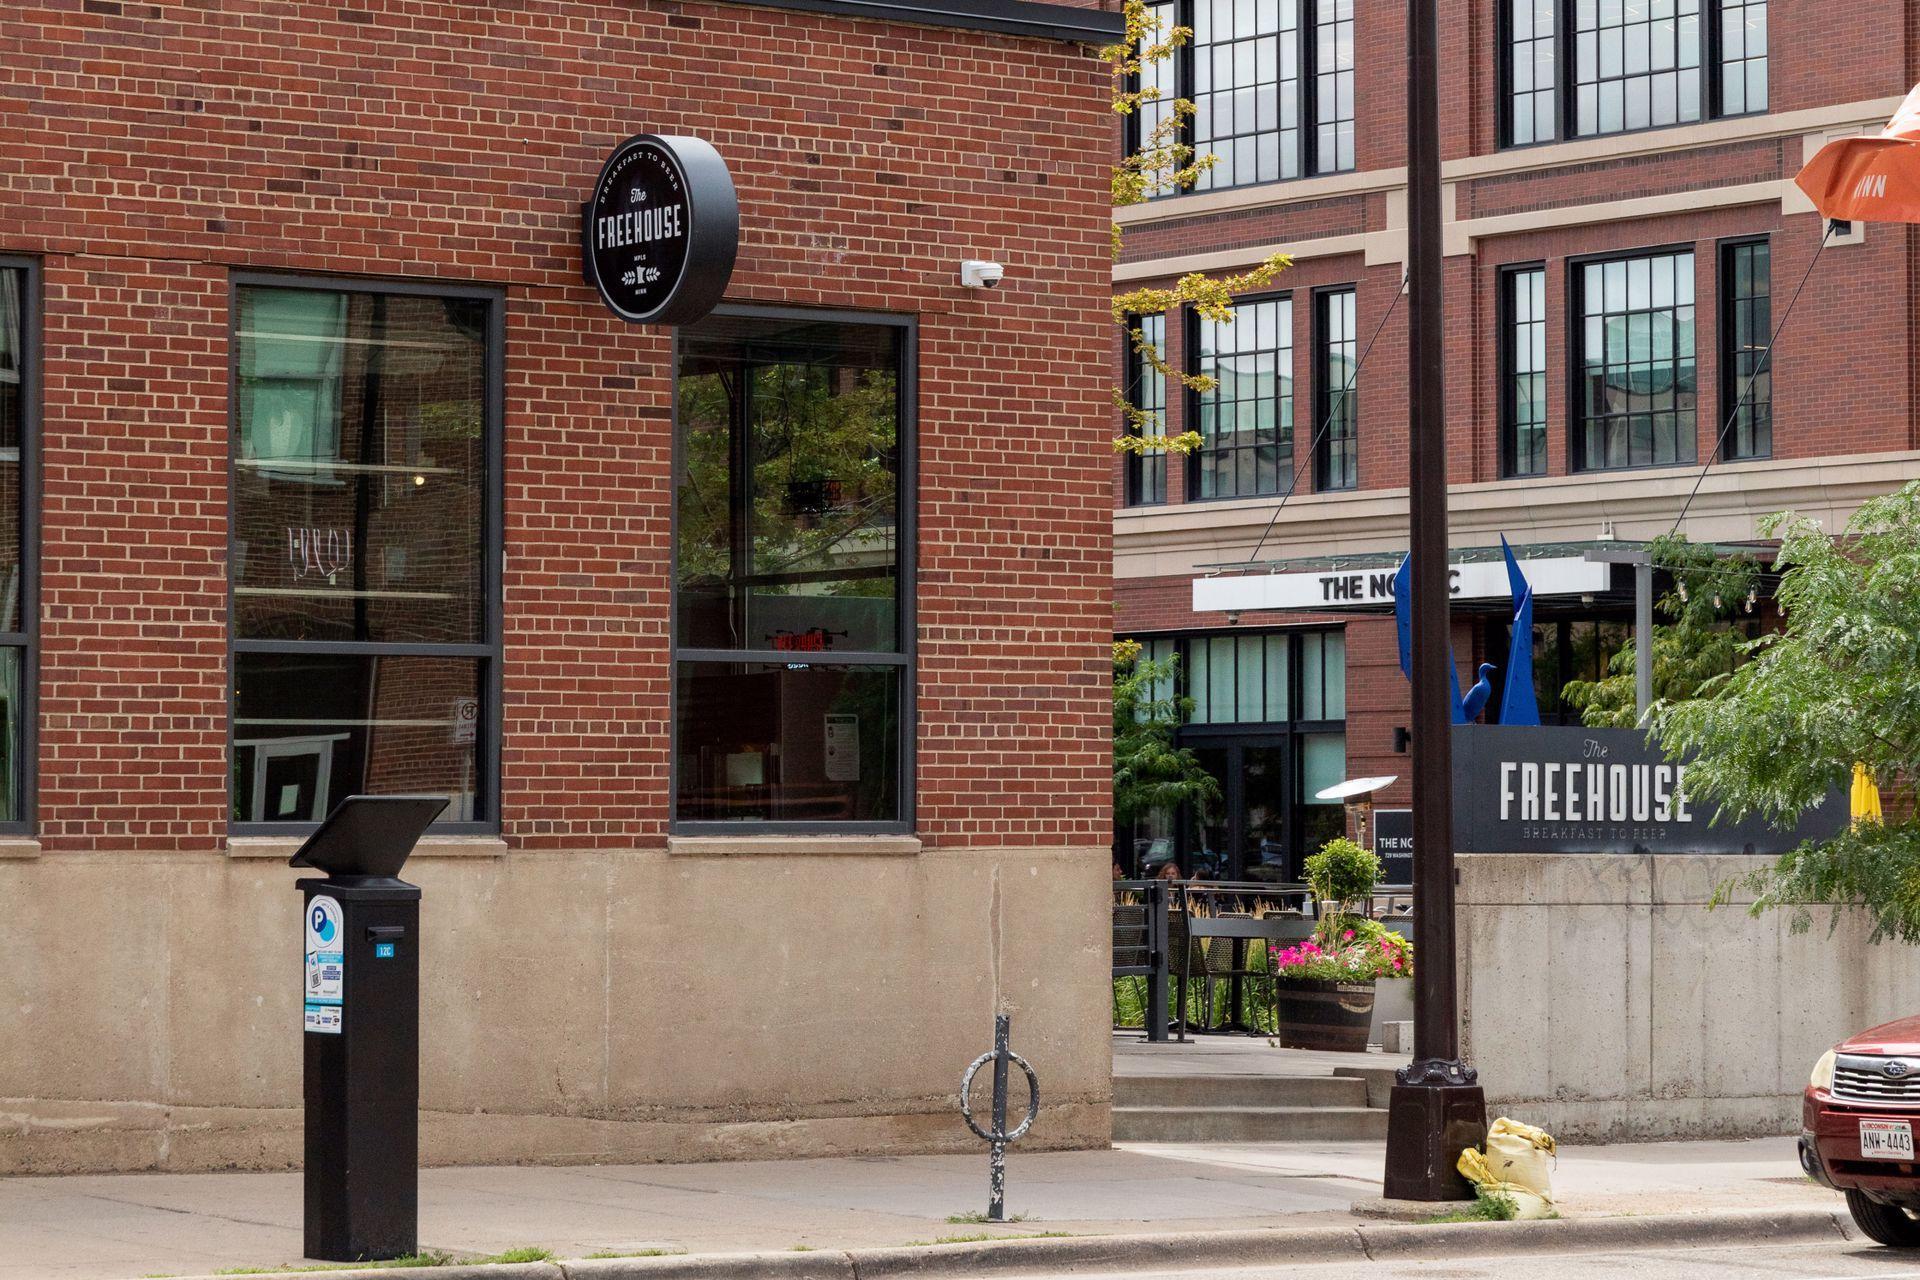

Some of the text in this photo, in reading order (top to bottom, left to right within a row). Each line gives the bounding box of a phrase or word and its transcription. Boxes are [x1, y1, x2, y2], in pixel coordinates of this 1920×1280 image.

[600, 152, 678, 204] BREAKFAST TO BEER
[630, 188, 648, 203] The
[599, 204, 681, 249] FREEHOUSE
[1319, 575, 1364, 601] THE
[1583, 738, 1609, 759] The
[1500, 761, 1692, 822] FREEHOUSE
[1379, 837, 1398, 848] THE
[1523, 827, 1603, 839] BREAKFAST
[1611, 828, 1628, 840] TO
[1864, 1132, 1911, 1151] ANW-4443
